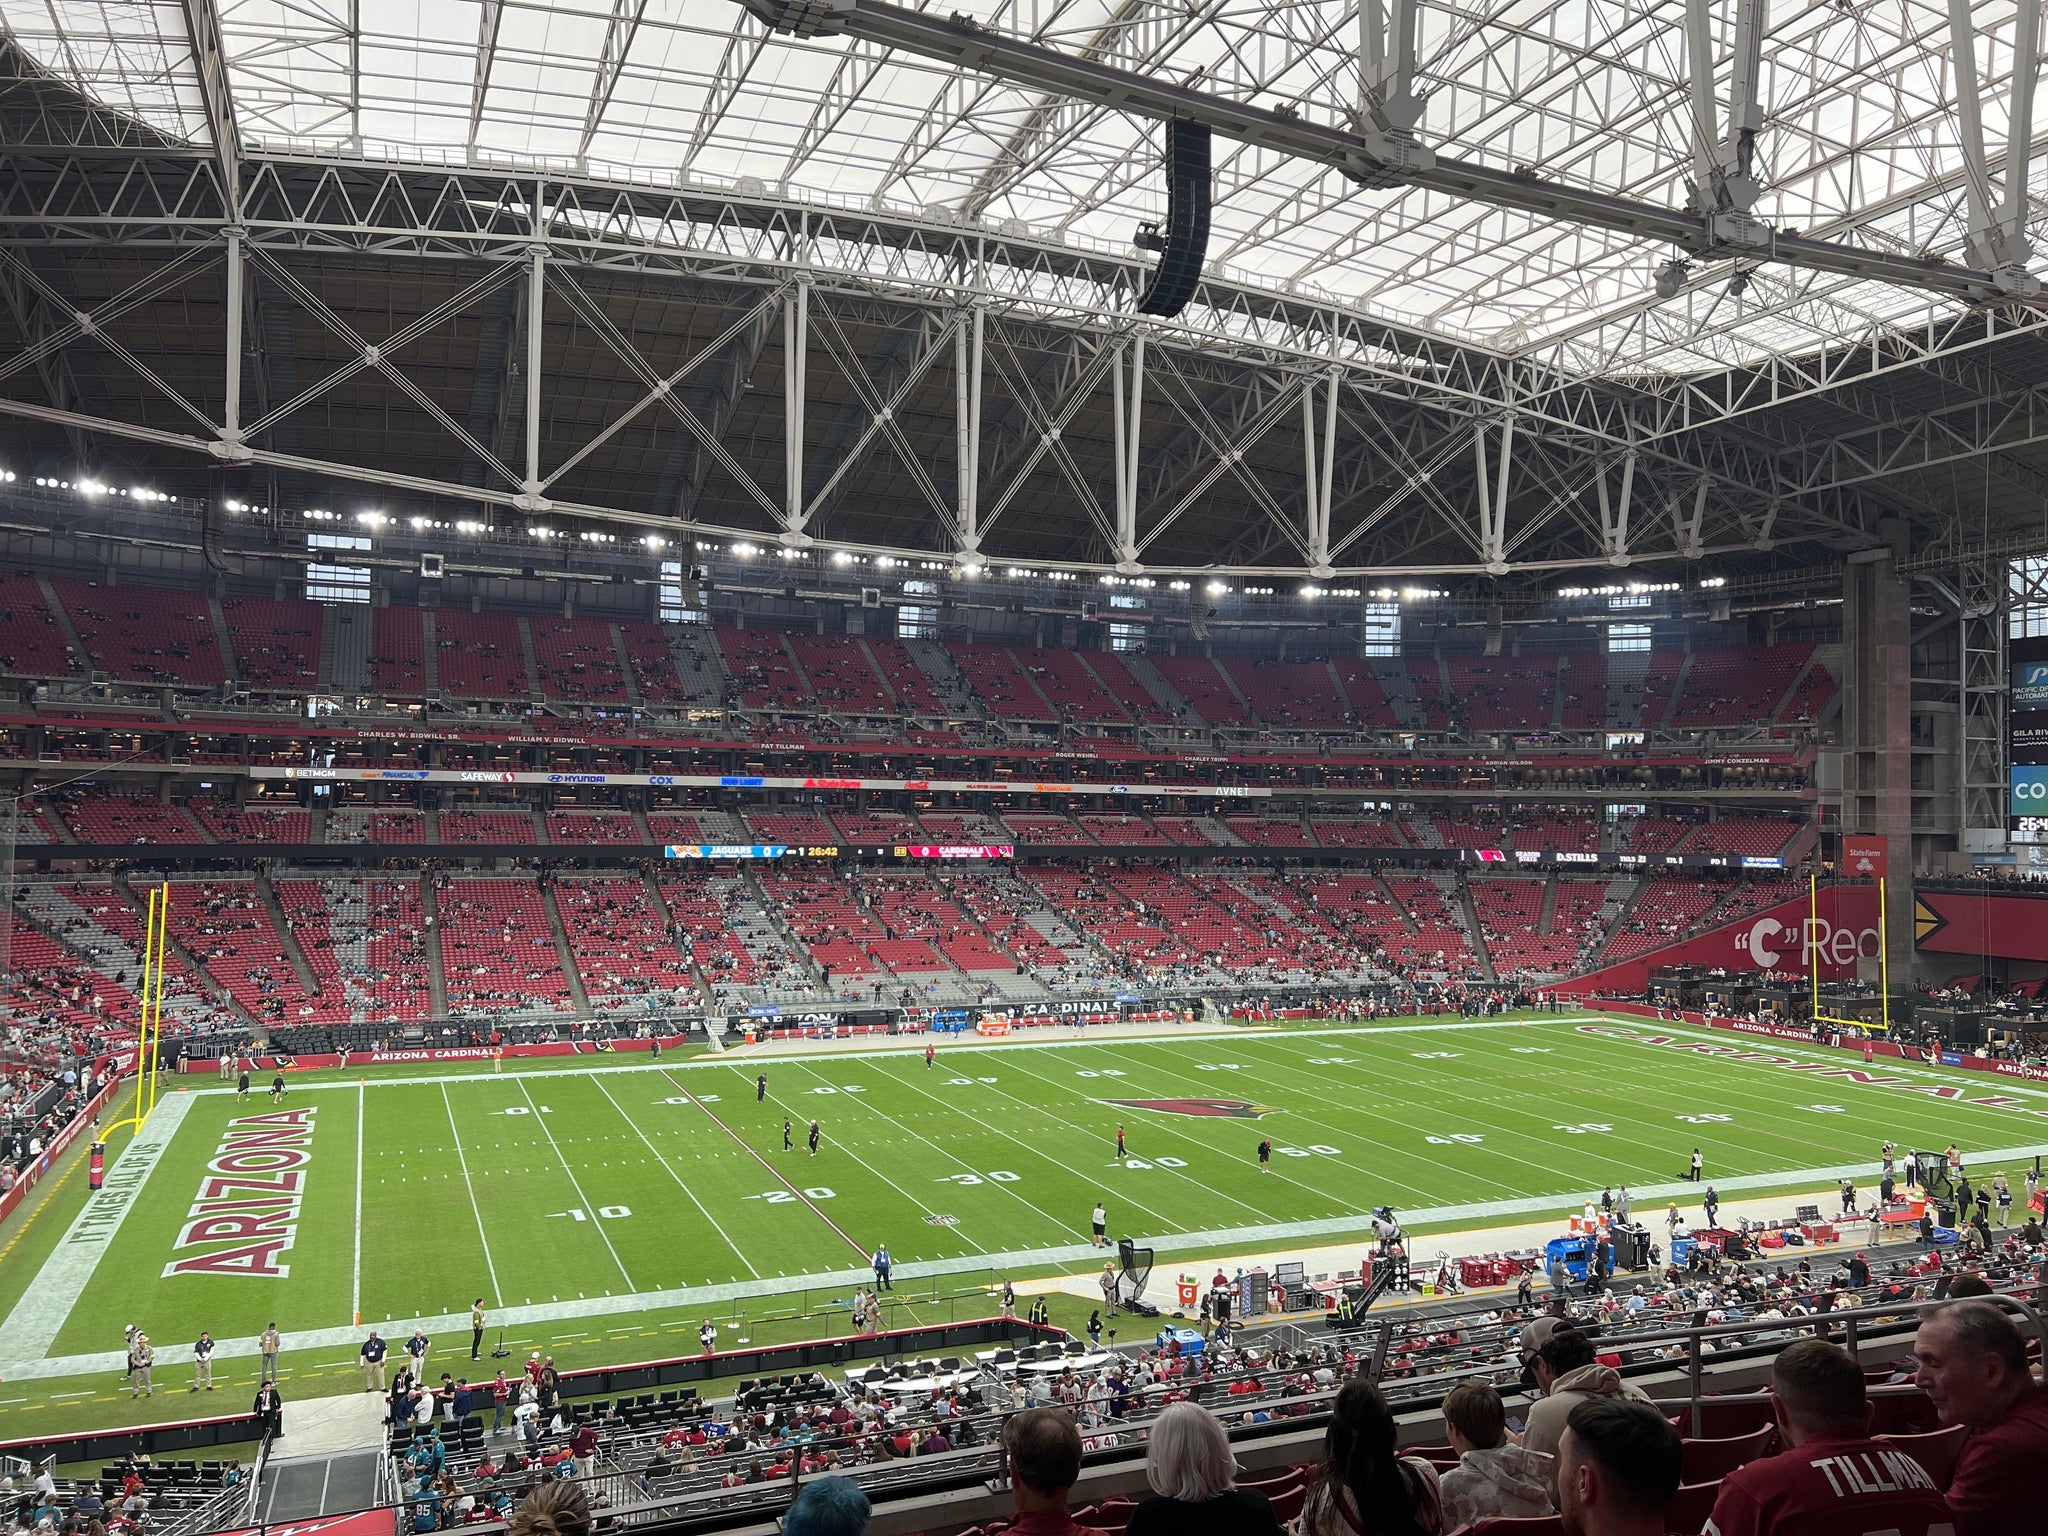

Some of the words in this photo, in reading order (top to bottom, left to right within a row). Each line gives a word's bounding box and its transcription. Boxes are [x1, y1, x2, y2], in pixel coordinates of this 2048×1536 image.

[2012, 686, 2038, 695] PACIFIC
[410, 732, 447, 740] BIDWILL,
[2013, 729, 2034, 737] GILA
[508, 735, 543, 743] WILLIAM
[553, 736, 586, 744] BIDWILL
[296, 770, 336, 778] BETMGM
[461, 772, 503, 780] SAFEWAY
[564, 775, 606, 783] HYUNDAI
[649, 776, 673, 784] COX
[1216, 787, 1250, 796] AVNET
[710, 846, 752, 855] JAGUARS
[763, 847, 771, 856] 0
[808, 847, 838, 856] 26:42
[938, 846, 984, 855] CARDINALS
[1556, 853, 1598, 862] D.STILLS
[1732, 1022, 1772, 1034] ARIZONA
[1774, 1028, 1817, 1042] CARDINA
[371, 1051, 429, 1061] ARIZONA
[1575, 1025, 2048, 1118] CARDINAL
[1674, 1112, 1733, 1124] 20
[1552, 1123, 1613, 1134] 30
[1425, 1133, 1484, 1145] 40
[128, 1142, 162, 1156] US
[1275, 1144, 1342, 1157] 50
[119, 1157, 153, 1169] OF
[1126, 1157, 1188, 1170] 40
[106, 1169, 146, 1188] ALL
[950, 1170, 1021, 1186] 30
[160, 1106, 319, 1279] ARIZONA
[762, 1187, 836, 1204] 20
[78, 1190, 133, 1230] TAKES
[568, 1205, 632, 1221] 10
[67, 1231, 109, 1244] IT
[1182, 1287, 1193, 1298] G
[1065, 1392, 1075, 1403] 18
[1810, 1450, 1938, 1498] TILLMAN
[416, 1504, 431, 1517] 85
